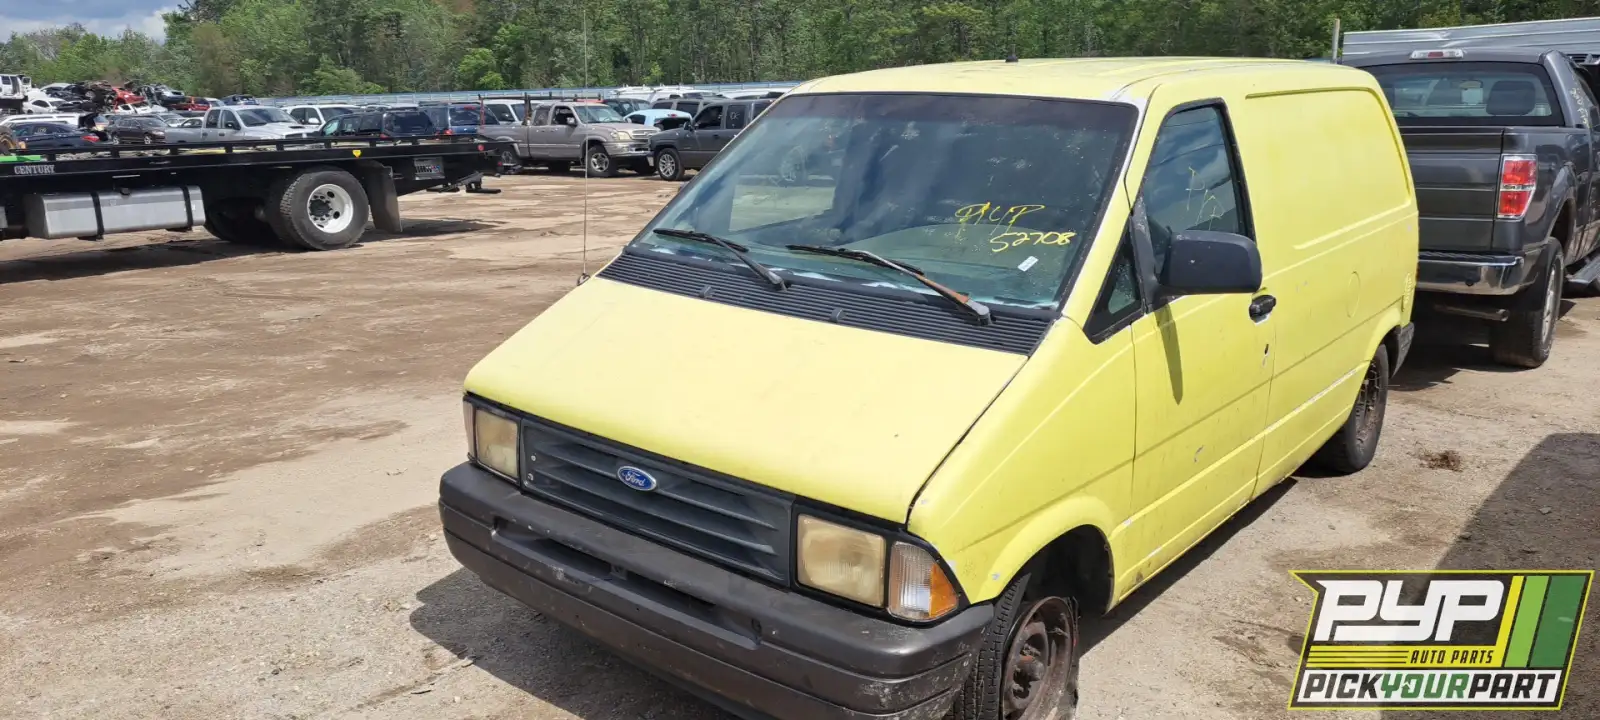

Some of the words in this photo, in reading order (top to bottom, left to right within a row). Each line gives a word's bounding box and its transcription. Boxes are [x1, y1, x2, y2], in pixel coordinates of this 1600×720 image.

[14, 164, 55, 175] CENTURY
[989, 231, 1077, 253] 52708
[621, 470, 646, 487] Ford
